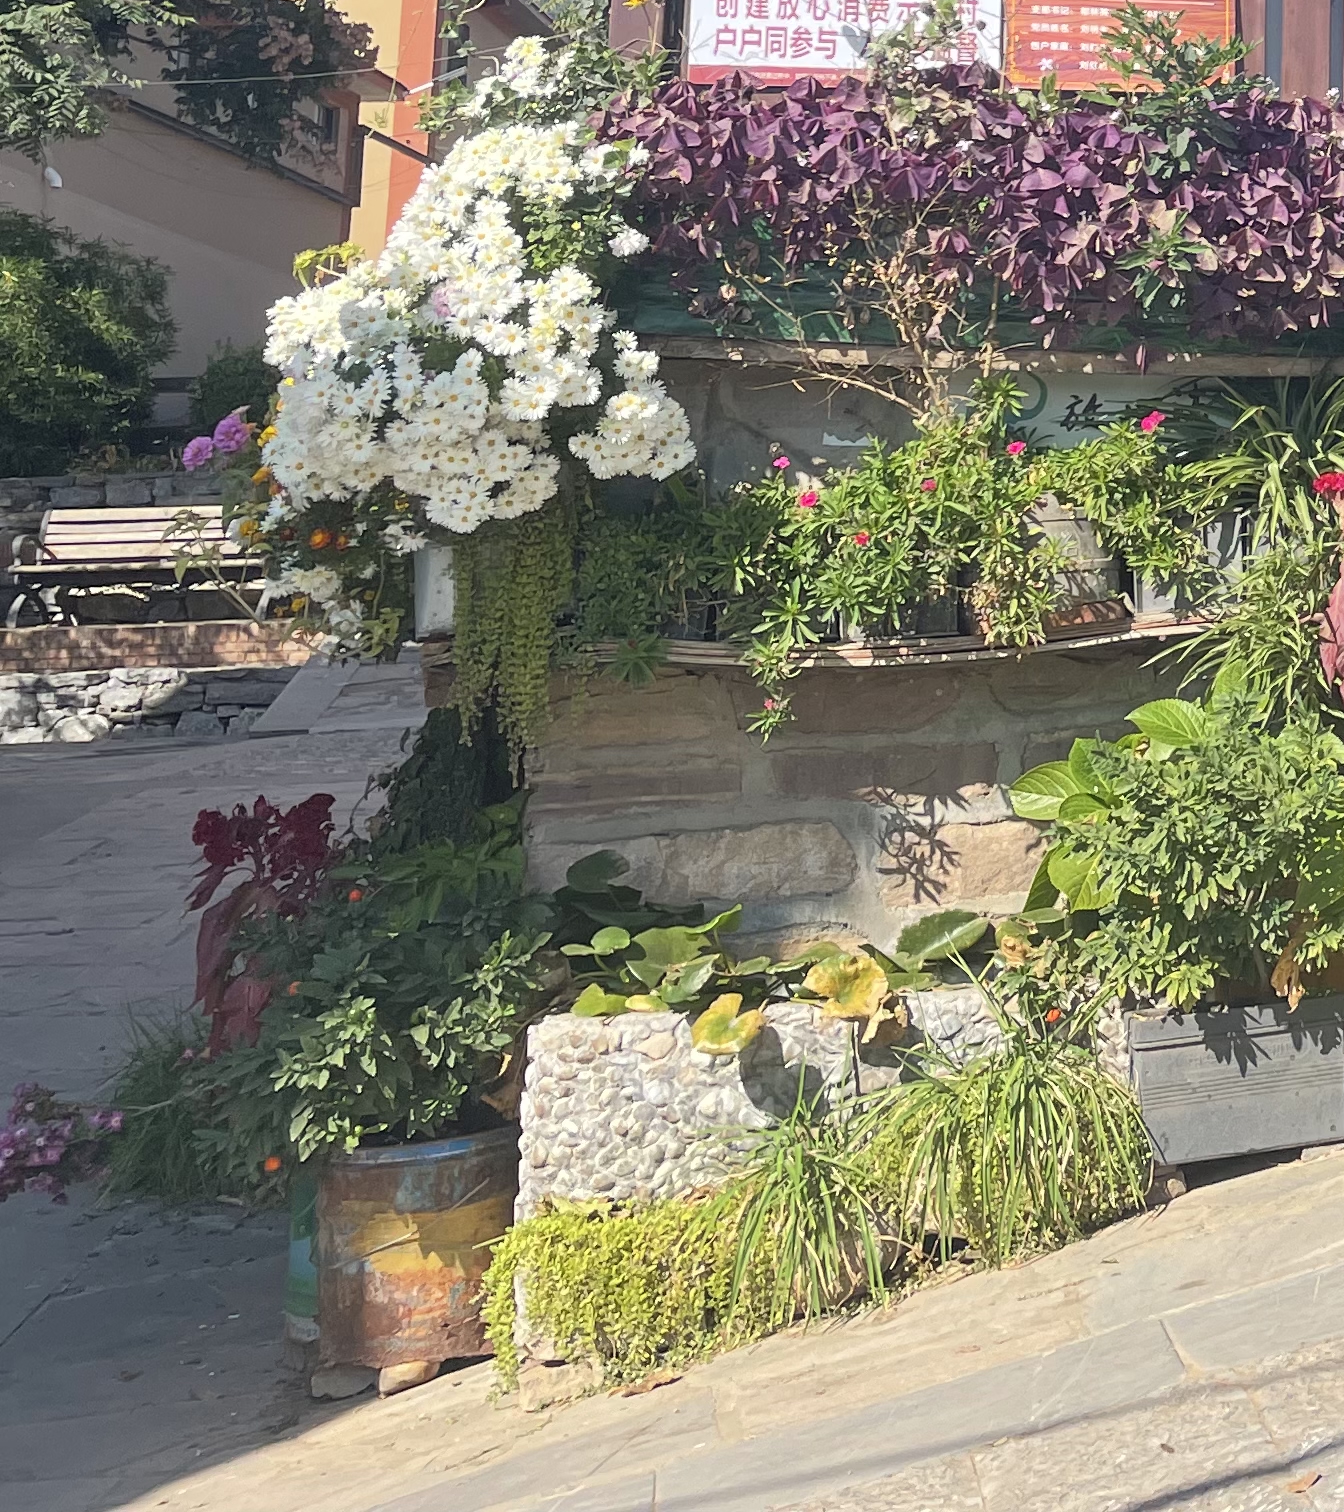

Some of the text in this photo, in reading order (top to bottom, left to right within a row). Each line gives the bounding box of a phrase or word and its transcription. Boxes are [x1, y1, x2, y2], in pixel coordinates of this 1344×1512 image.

[713, 25, 837, 59] 户户同参与
